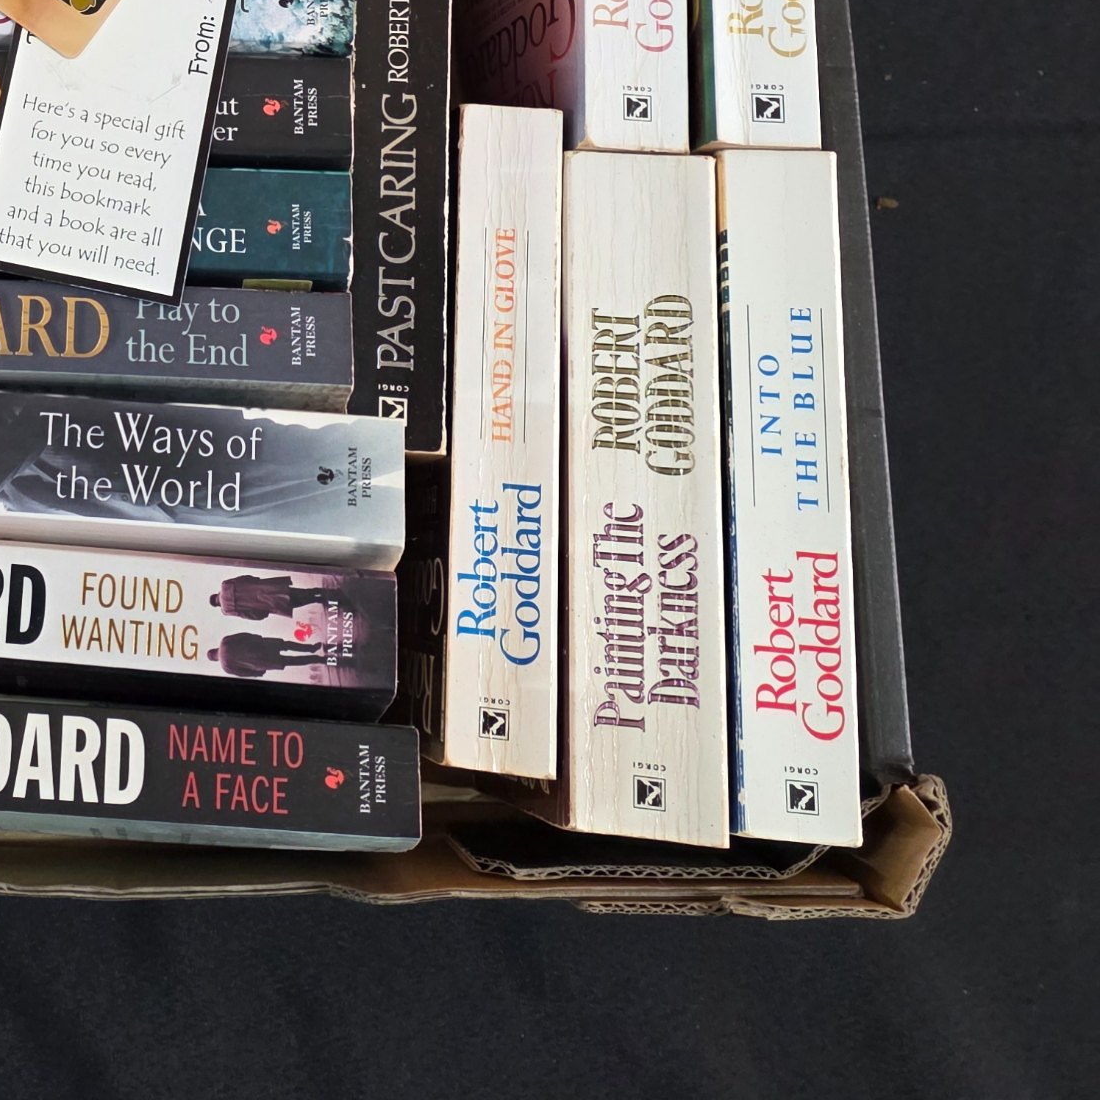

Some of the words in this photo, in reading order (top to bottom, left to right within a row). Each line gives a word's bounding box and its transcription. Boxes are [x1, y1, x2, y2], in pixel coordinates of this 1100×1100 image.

[188, 16, 215, 75] From:
[31, 120, 57, 140] for
[60, 133, 94, 150] you
[99, 140, 119, 154] so
[124, 145, 171, 169] every
[80, 109, 89, 122] a
[94, 112, 151, 134] special
[155, 120, 186, 141] gift
[25, 175, 55, 197] this
[60, 182, 151, 217] bookmark
[32, 151, 72, 173] time
[76, 163, 110, 180] you
[117, 172, 157, 192] read,
[378, 93, 417, 264] CARING
[7, 205, 39, 224] and
[44, 212, 53, 226] a
[59, 209, 105, 236] book
[109, 226, 137, 242] are
[141, 227, 163, 247] all
[37, 240, 72, 257] you
[78, 245, 109, 264] will
[113, 256, 160, 277] need.
[495, 227, 517, 314] GLOVE
[377, 266, 416, 372] PAST
[494, 320, 515, 354] IN
[790, 306, 817, 413] BLUE
[491, 357, 515, 444] HAND
[757, 353, 784, 457] INTO
[40, 411, 105, 449] The
[114, 411, 215, 468] Ways
[226, 427, 263, 461] of
[56, 466, 113, 502] the
[121, 463, 241, 512] World
[347, 446, 358, 508] BANTAM
[361, 456, 371, 500] PRESS
[793, 429, 819, 511] THE
[753, 567, 798, 714] Robert
[797, 551, 845, 741] Goddard
[168, 723, 256, 766] NAME
[267, 730, 304, 769] TO
[182, 772, 200, 810] A
[214, 774, 289, 815] FACE
[359, 743, 371, 815] BANTAM
[374, 755, 386, 805] PRESS
